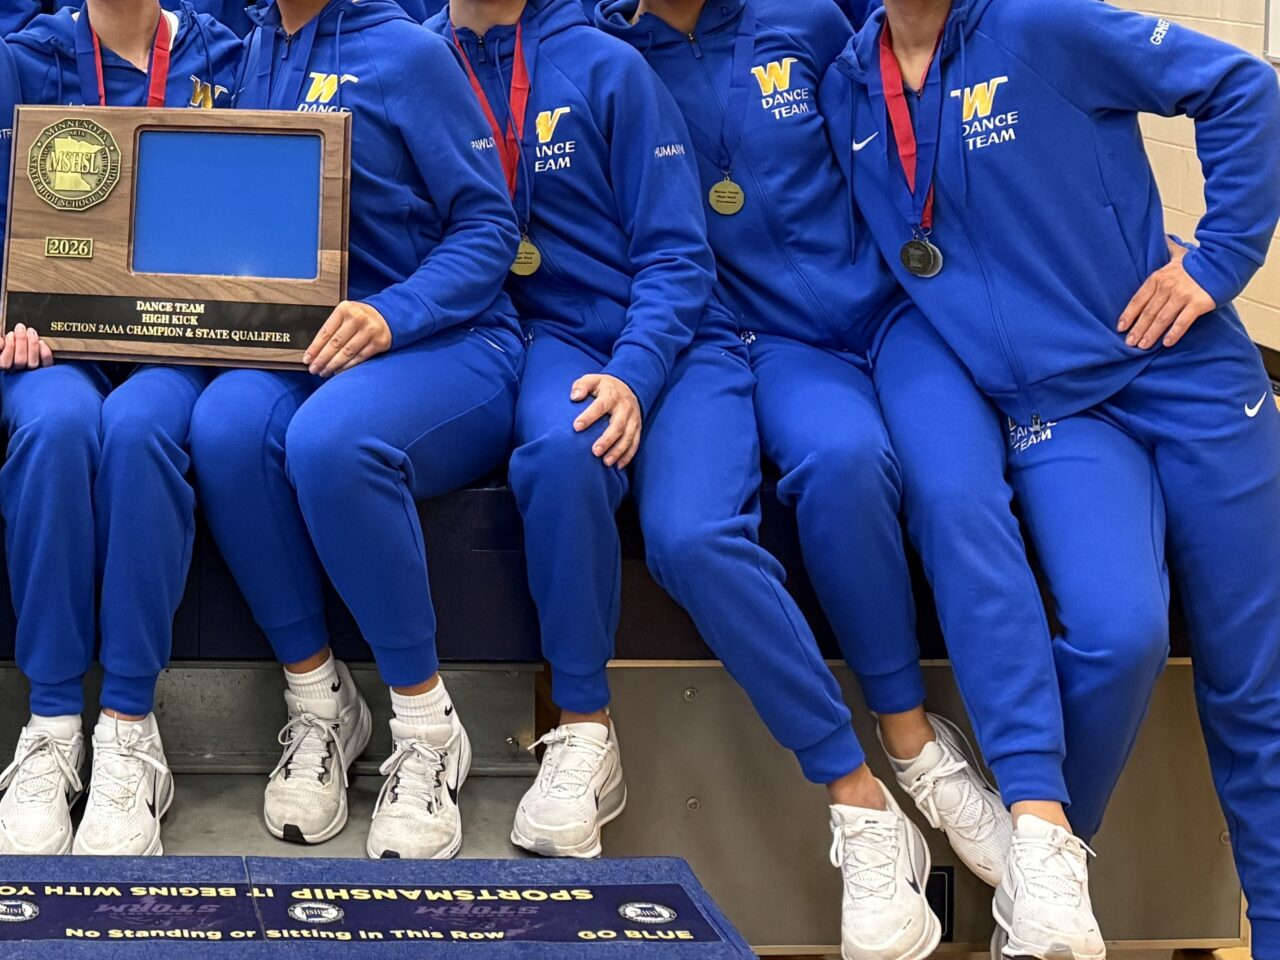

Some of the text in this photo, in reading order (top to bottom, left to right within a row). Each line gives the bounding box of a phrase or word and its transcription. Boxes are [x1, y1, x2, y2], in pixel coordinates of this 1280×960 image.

[751, 57, 799, 96] W
[305, 71, 359, 103] W
[761, 88, 809, 109] DANCE
[950, 75, 1009, 122] W
[771, 102, 810, 120] TEAM
[45, 120, 107, 140] MINNESOTA
[965, 127, 1016, 151] TEAM
[48, 151, 99, 174] MSHSL
[535, 156, 571, 172] EAM
[30, 156, 41, 184] STATE
[37, 185, 58, 204] HIGH
[60, 195, 97, 207] SCHOOL
[99, 159, 118, 197] LEAGUE
[49, 239, 89, 255] 2026
[136, 301, 205, 314] DANCE TEAM
[142, 314, 198, 325] HIGH KICK
[51, 321, 291, 343] SECTION 2AAA CHAMPION & STATE QUALIFIER
[45, 885, 122, 897] WITH
[131, 886, 237, 897] BEGINS
[246, 887, 274, 898] IT
[291, 887, 595, 901] SPORTSMANSHIP
[65, 928, 101, 938] No
[107, 928, 223, 940] Standing
[230, 929, 256, 939] or
[265, 928, 352, 940] Sitting
[388, 930, 441, 939] This
[451, 930, 505, 940] Row
[577, 930, 694, 940] GO BLUE
